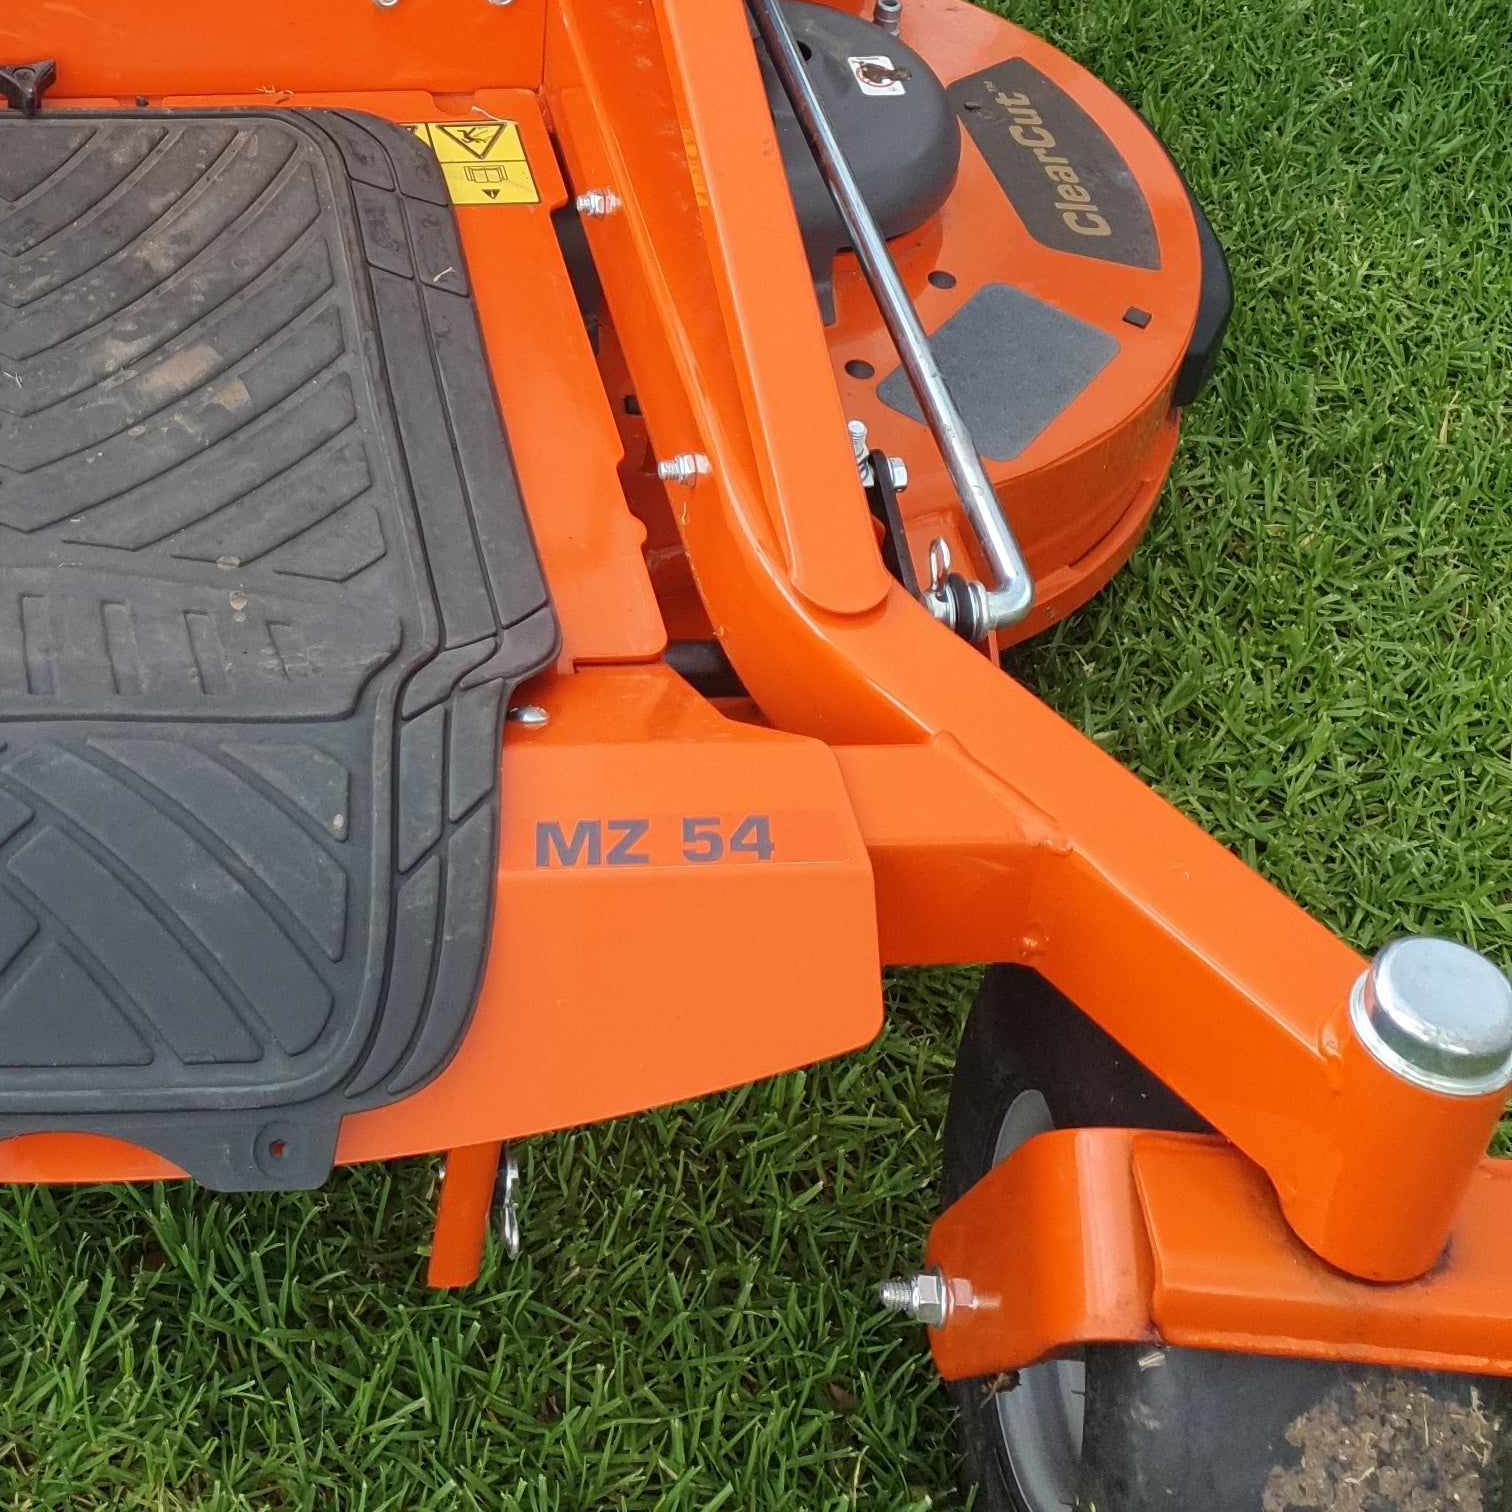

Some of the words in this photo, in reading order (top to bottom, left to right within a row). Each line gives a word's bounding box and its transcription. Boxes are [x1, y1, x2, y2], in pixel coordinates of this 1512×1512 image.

[995, 91, 1112, 236] ClearCut
[535, 818, 650, 869] MZ
[681, 814, 775, 863] 54
